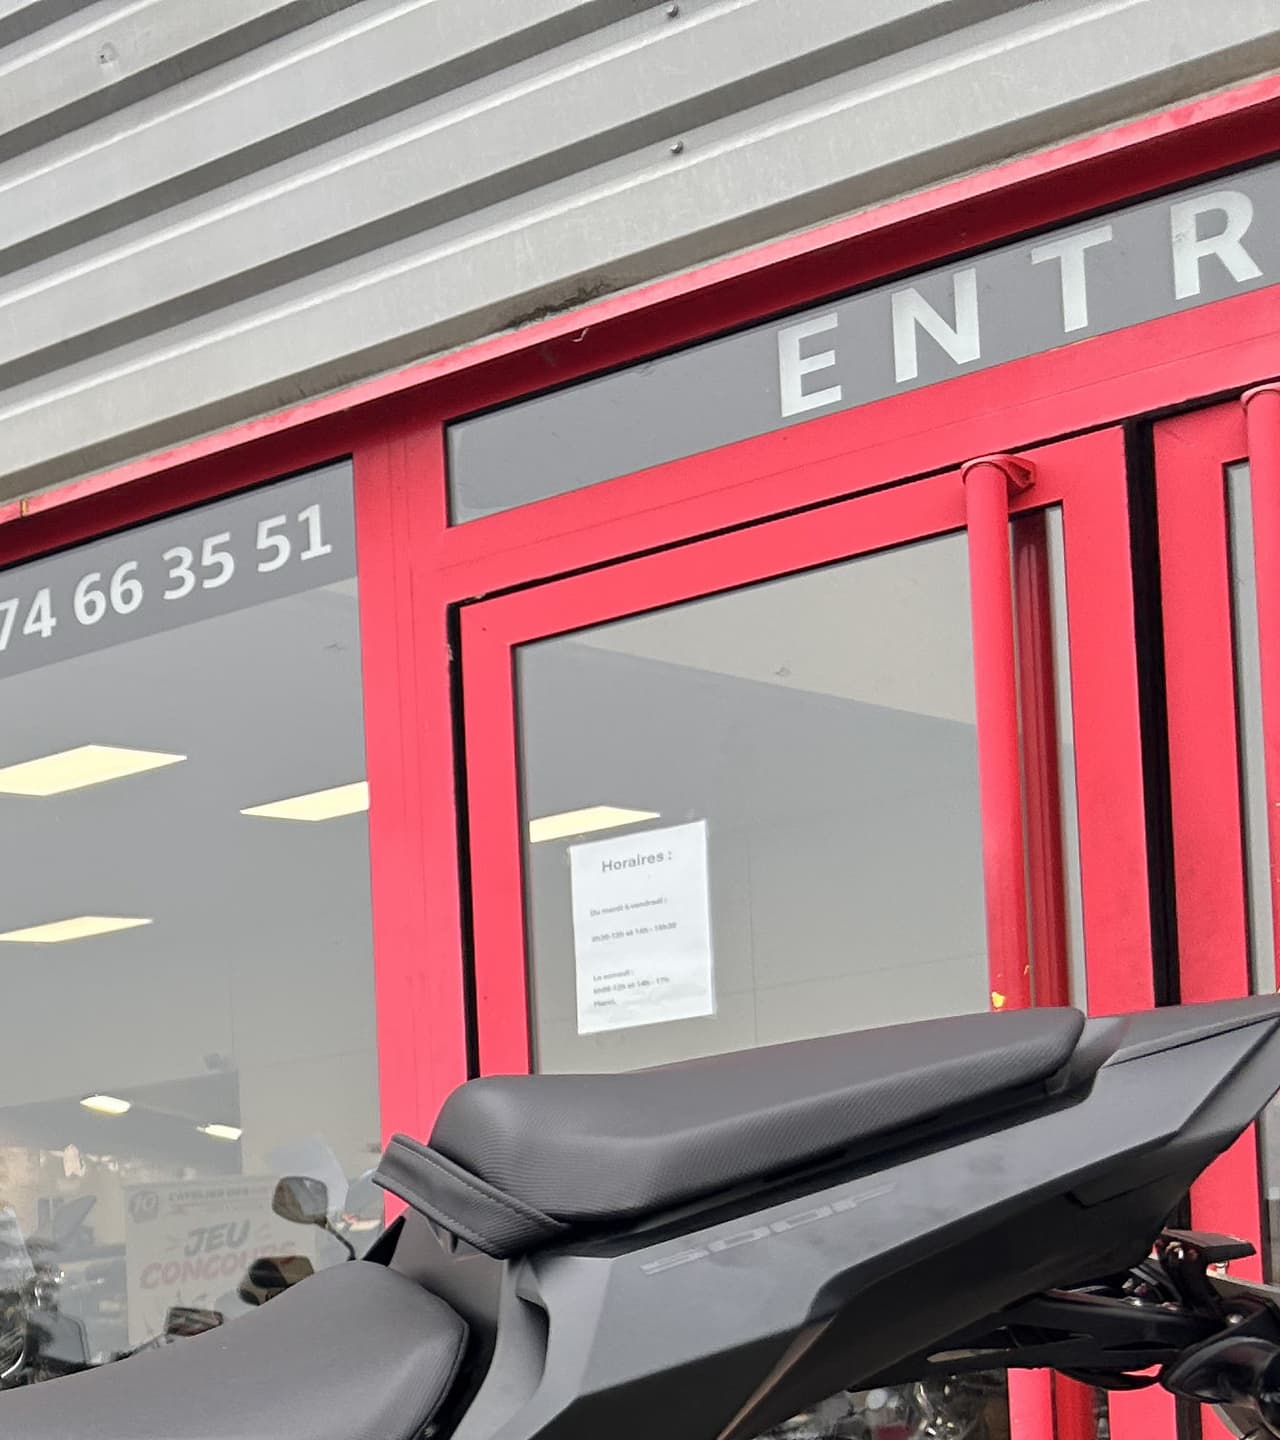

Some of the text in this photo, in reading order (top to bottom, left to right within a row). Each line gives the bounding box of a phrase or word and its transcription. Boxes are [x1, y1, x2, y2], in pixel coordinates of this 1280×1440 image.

[776, 189, 1264, 418] ENTR
[72, 560, 143, 628] 66
[162, 530, 236, 601] 35
[254, 503, 334, 575] 51
[601, 850, 665, 873] Horaires
[183, 1219, 251, 1257] JEU
